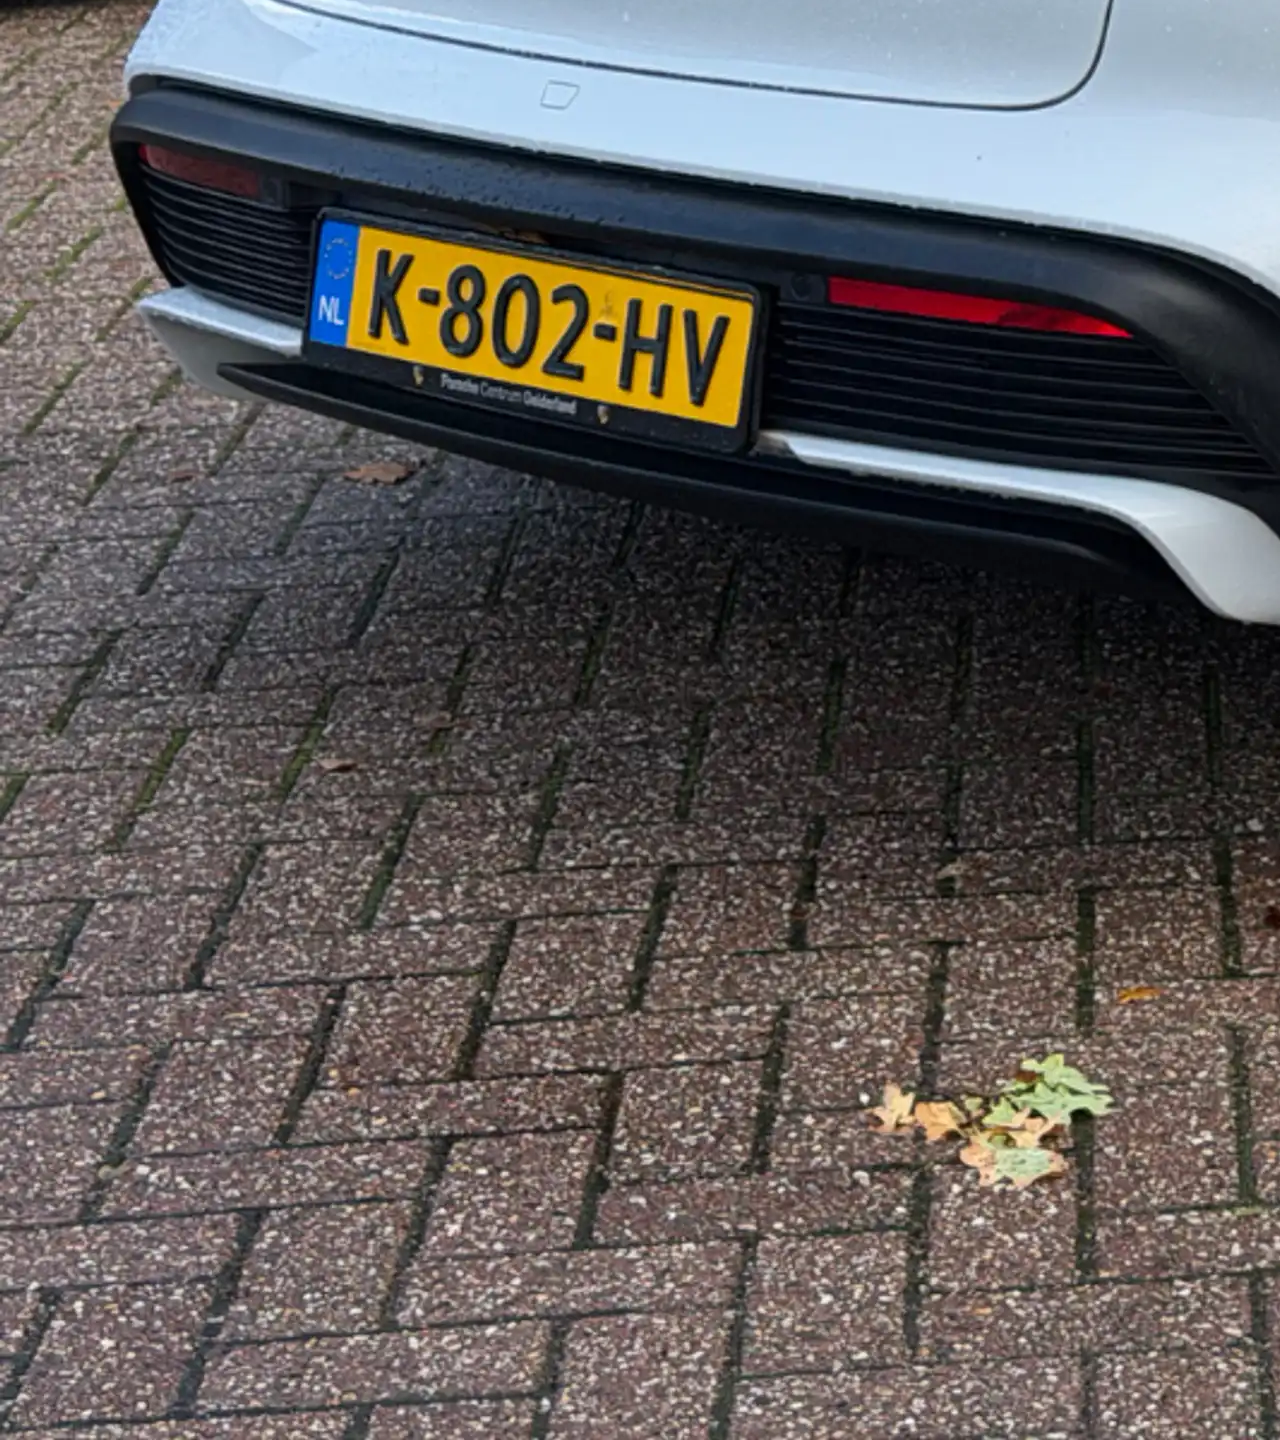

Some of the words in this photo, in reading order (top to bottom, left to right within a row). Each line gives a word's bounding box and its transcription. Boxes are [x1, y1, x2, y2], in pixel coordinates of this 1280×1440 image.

[317, 294, 345, 327] NL
[367, 248, 732, 408] K-802-HV
[480, 382, 523, 403] Centrum
